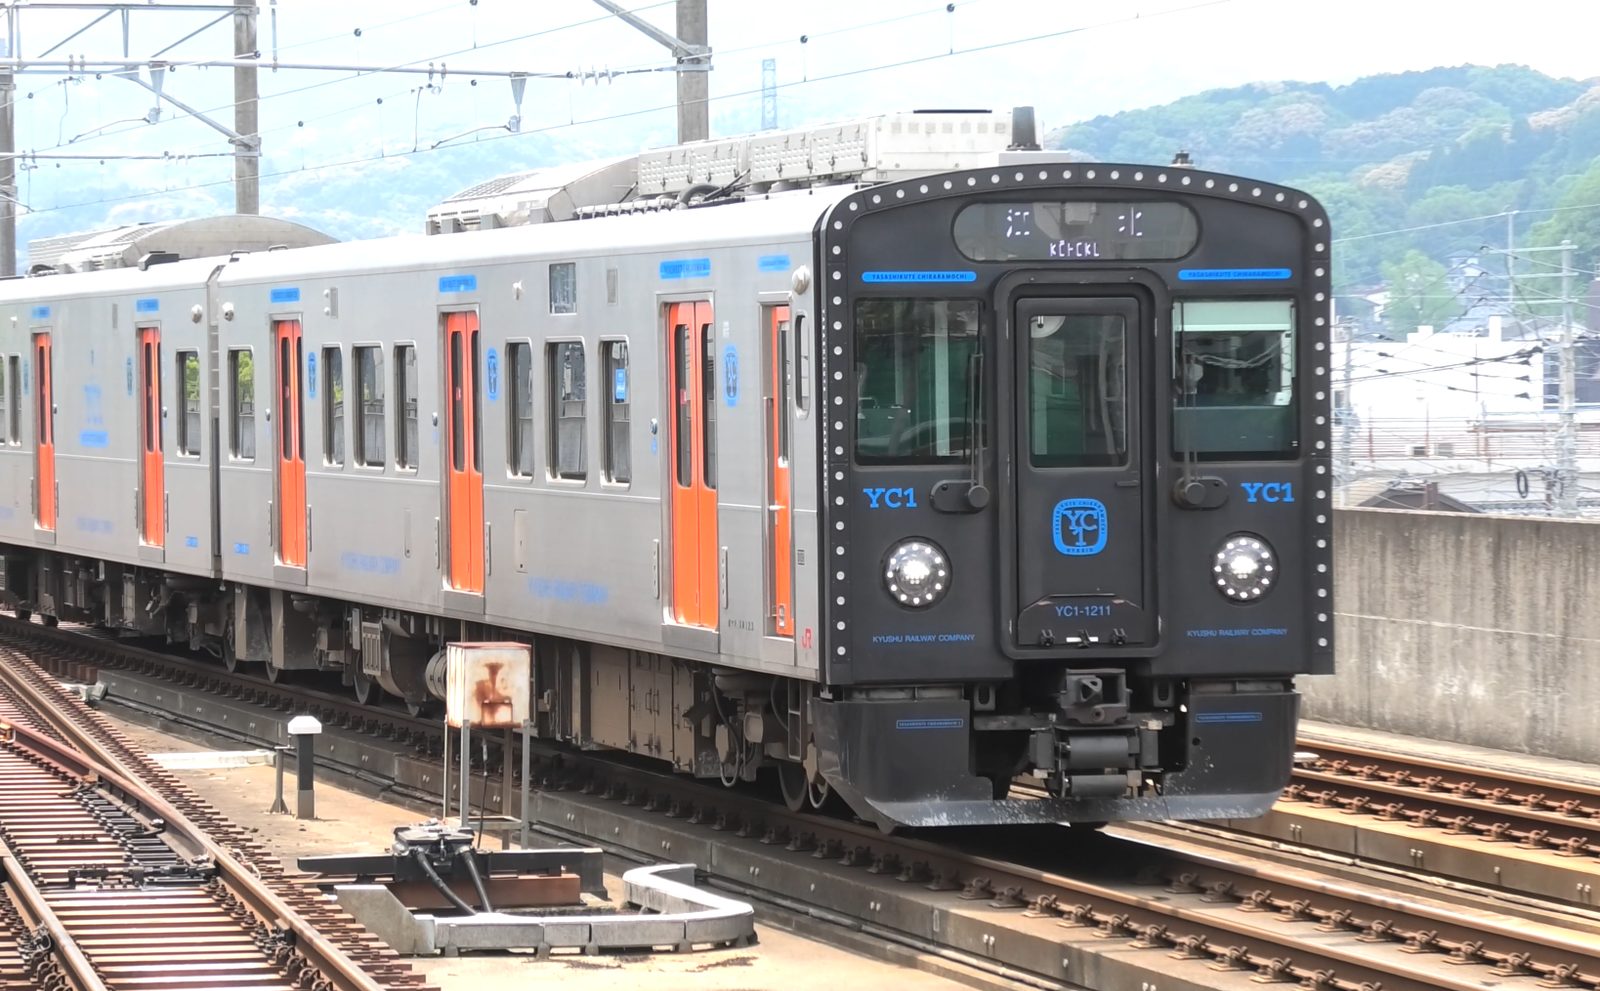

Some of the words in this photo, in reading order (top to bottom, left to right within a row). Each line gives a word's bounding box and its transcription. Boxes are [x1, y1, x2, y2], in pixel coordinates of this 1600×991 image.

[863, 487, 917, 508] YC1
[1240, 482, 1295, 503] YC1
[1055, 605, 1111, 617] YC1-1211
[872, 635, 903, 643] KYUSHU
[904, 634, 936, 642] RAILWAY
[938, 633, 976, 642] COMPANY
